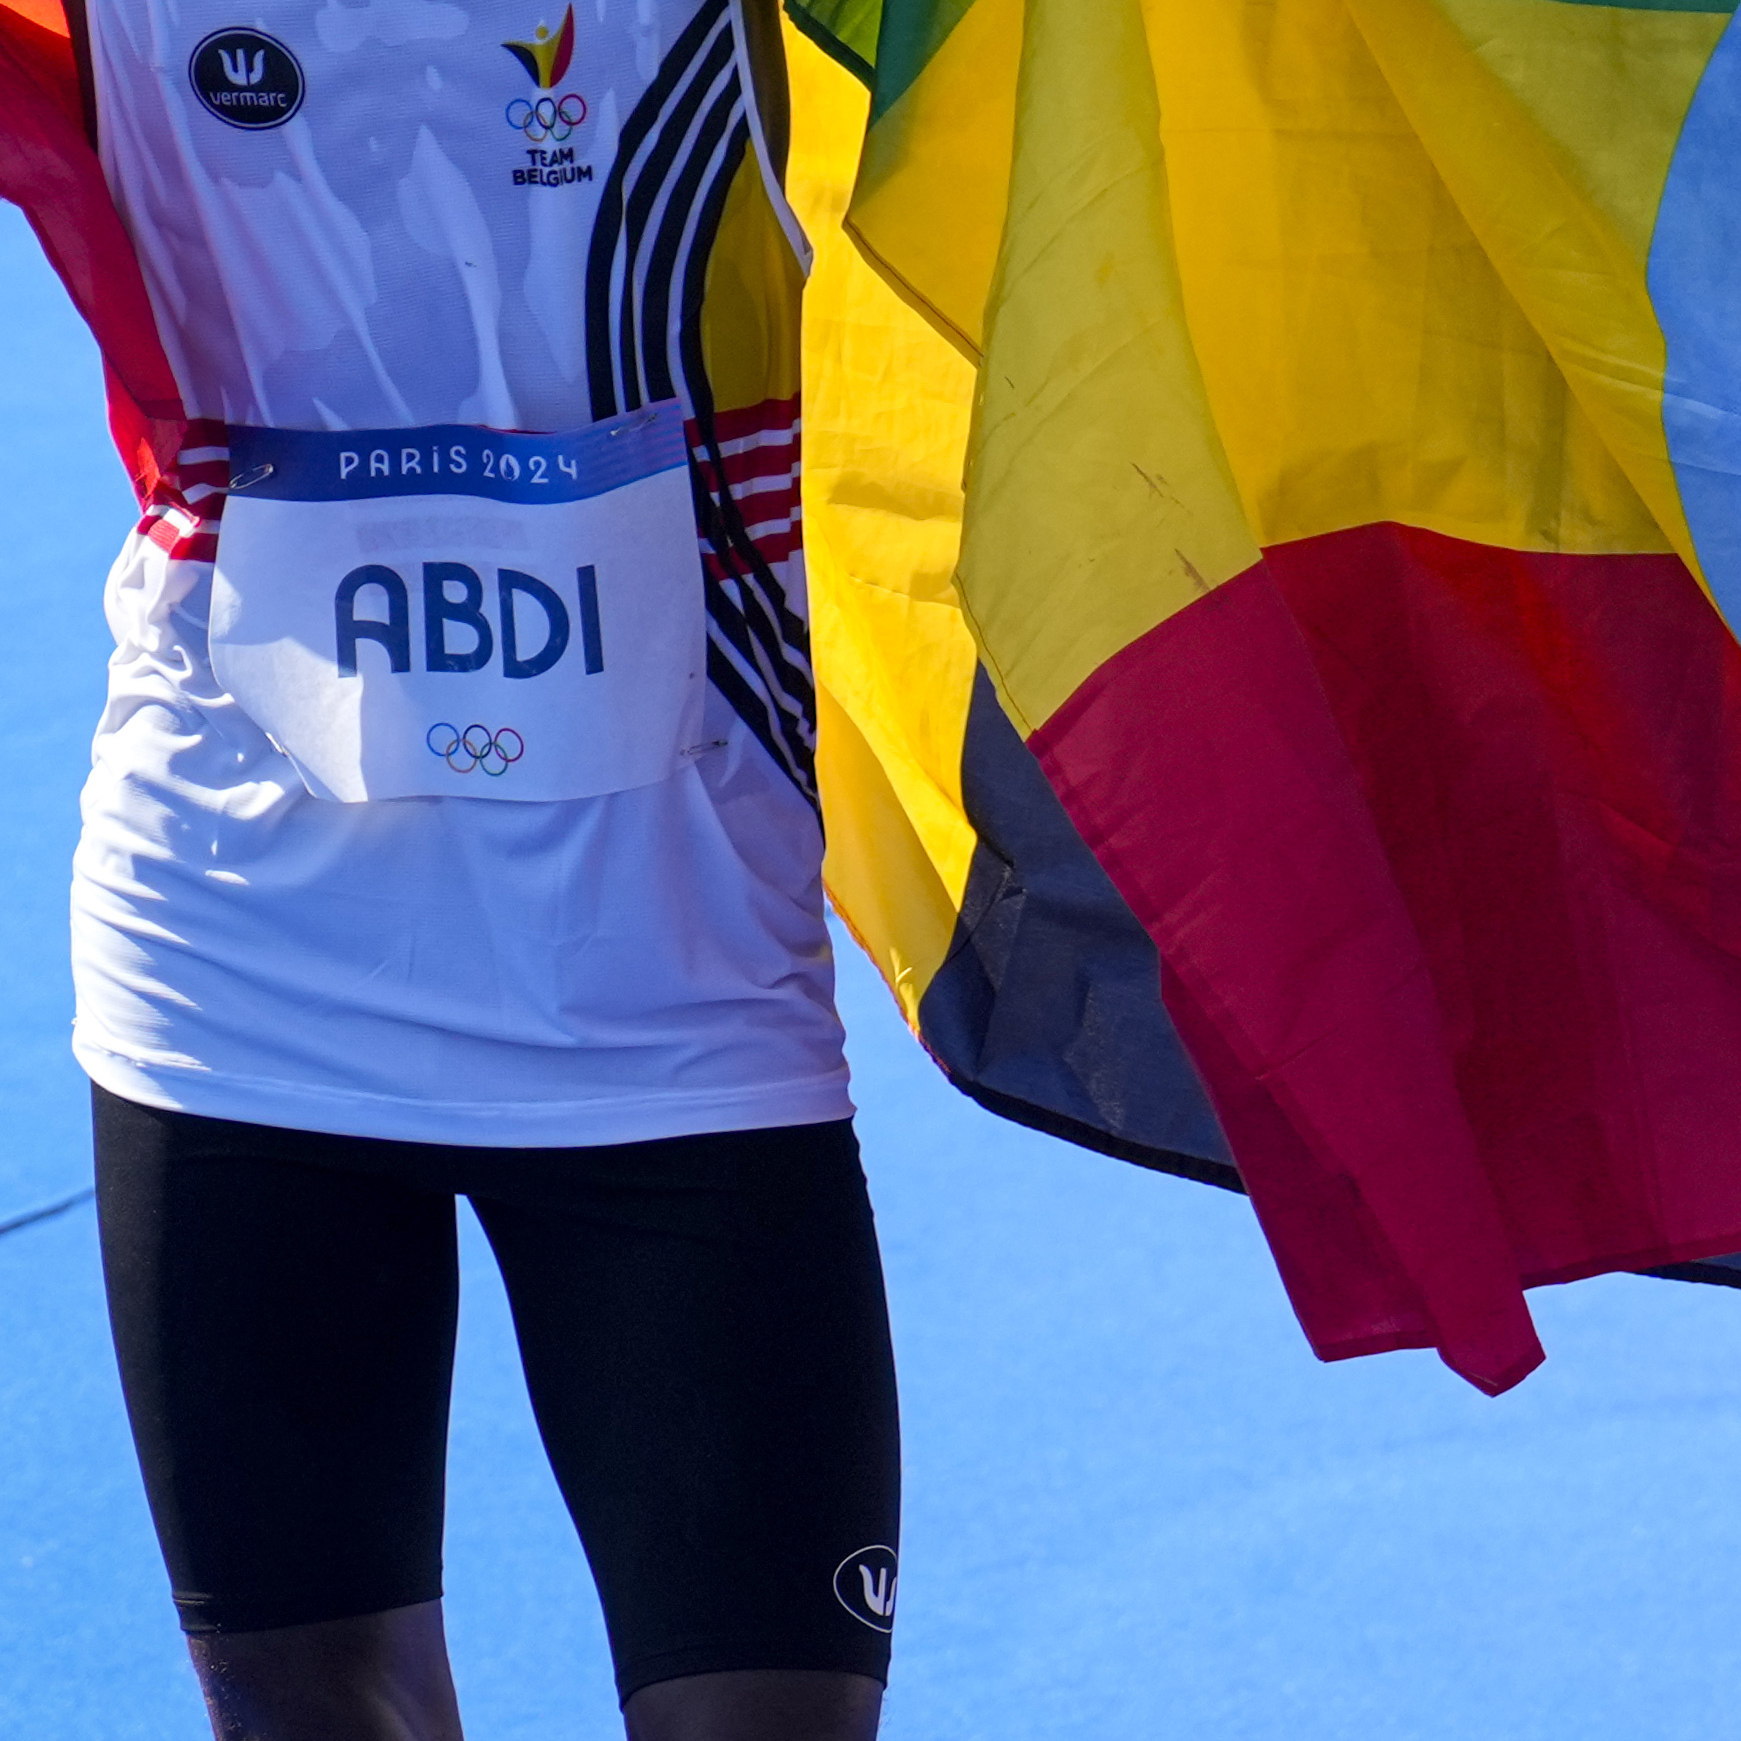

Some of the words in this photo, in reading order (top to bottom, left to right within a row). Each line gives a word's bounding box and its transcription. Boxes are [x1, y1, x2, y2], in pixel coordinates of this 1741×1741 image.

[209, 91, 288, 108] vermarc
[526, 147, 574, 167] TEAM
[512, 165, 593, 188] BELGIUM
[482, 449, 578, 484] 2024
[334, 561, 605, 679] ABDI
